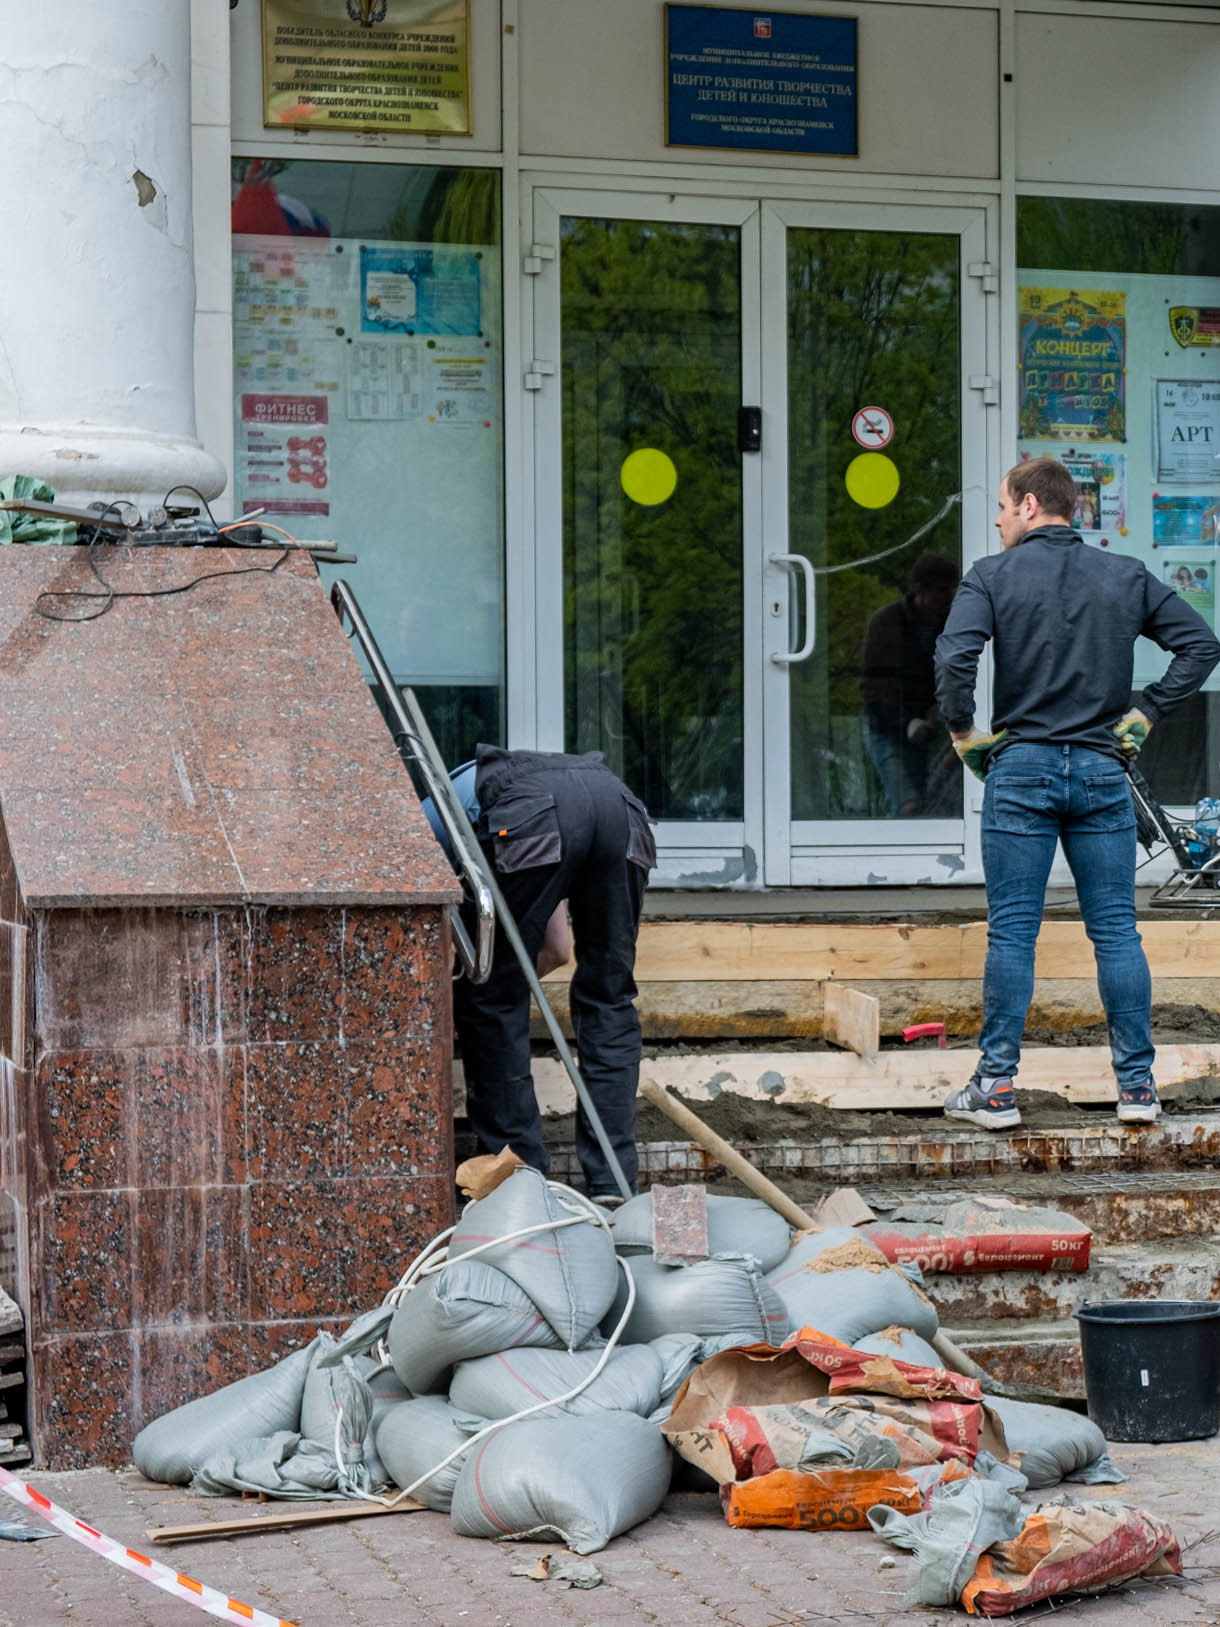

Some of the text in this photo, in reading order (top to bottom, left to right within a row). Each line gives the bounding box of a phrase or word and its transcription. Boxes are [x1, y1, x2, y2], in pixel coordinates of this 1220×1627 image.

[673, 73, 852, 96] ЦЕНТР РАЗВИТИЯ ТВОРЧЕСТВА
[697, 88, 828, 109] ДЕТЕЙ И ЮНОШЕСТВА
[1035, 339, 1114, 358] КОНЦЕРТ
[255, 402, 317, 416] ФИТНЕС
[1171, 425, 1214, 442] АРТ
[978, 1252, 1045, 1263] Евроцемент
[798, 1505, 859, 1528] 500
